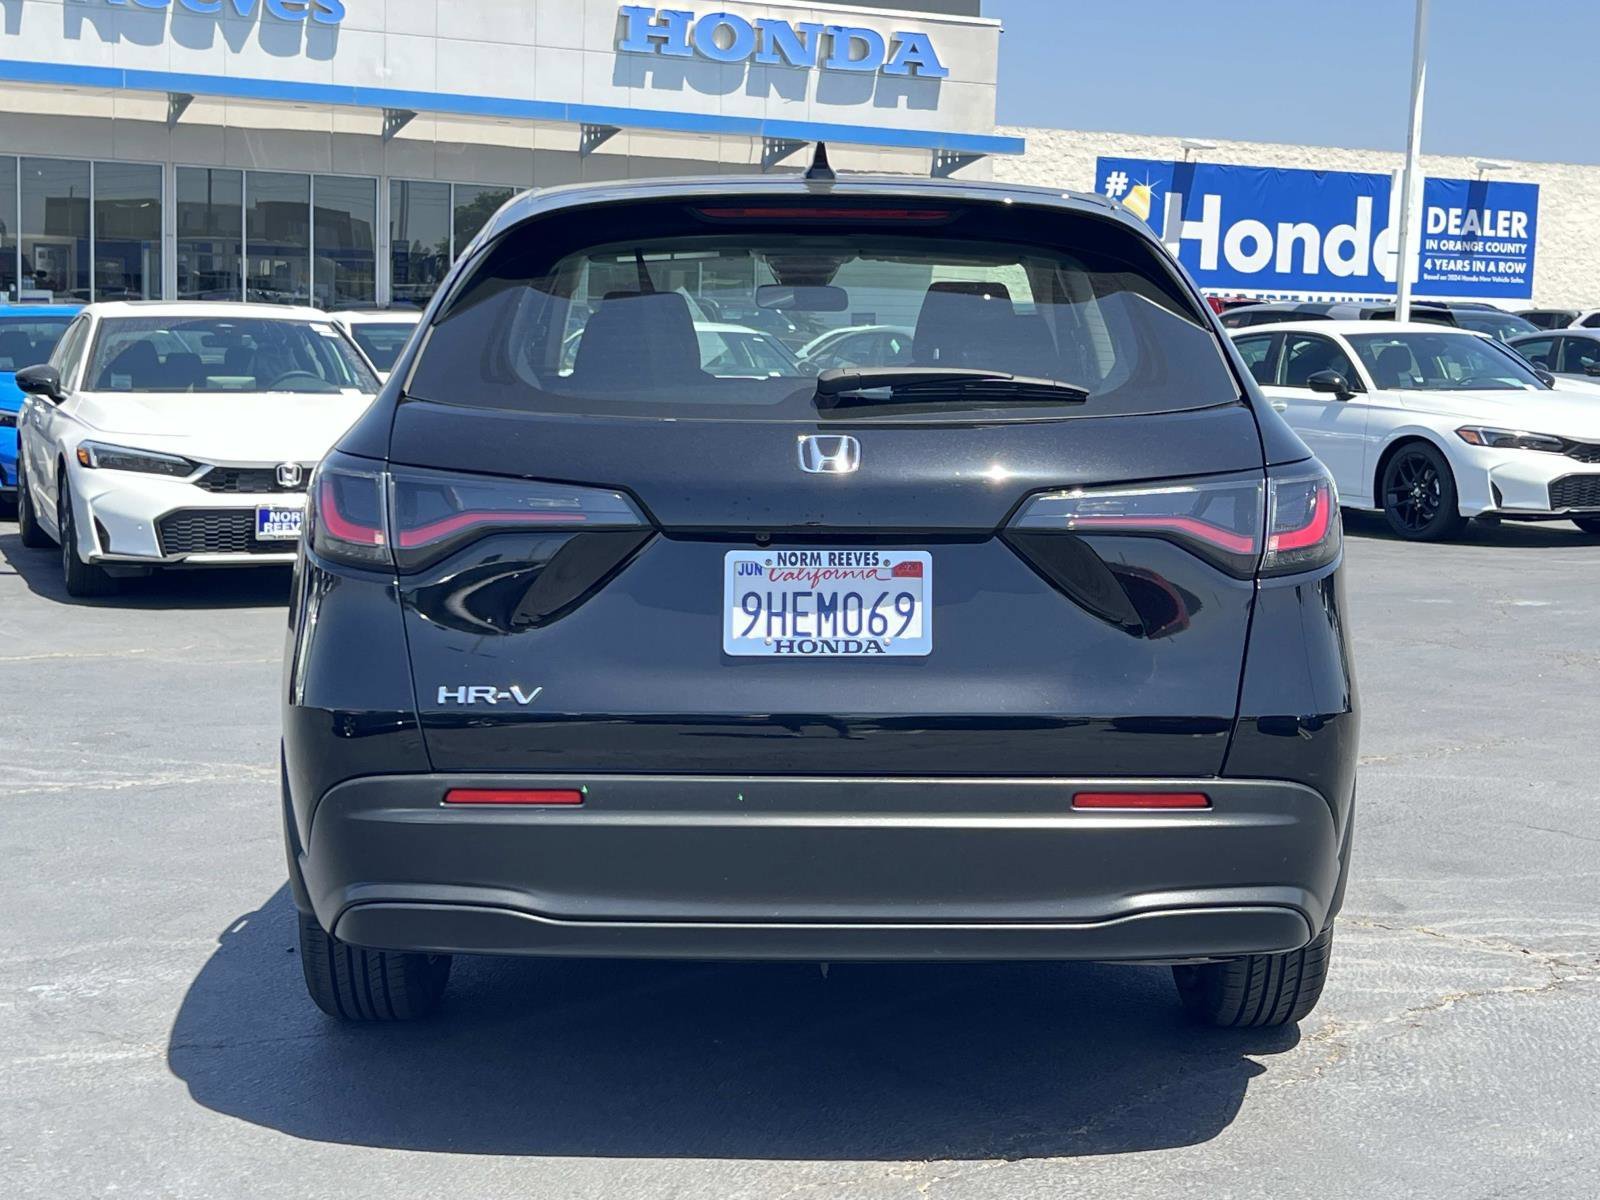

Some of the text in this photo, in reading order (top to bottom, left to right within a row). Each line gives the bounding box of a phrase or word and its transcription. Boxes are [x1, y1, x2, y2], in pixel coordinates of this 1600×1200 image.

[614, 5, 949, 78] HONDA
[1426, 206, 1529, 239] DEALER
[1425, 239, 1527, 254] IN ORANGE COUNTY
[1424, 258, 1527, 274] 4 YEARS IN A ROW
[269, 511, 304, 523] NOR
[777, 551, 880, 567] NORM REEVES
[738, 562, 763, 576] JUN
[768, 567, 892, 590] California
[740, 591, 916, 637] 9HEM069
[773, 639, 886, 654] HONDA
[437, 685, 543, 704] HR-V
